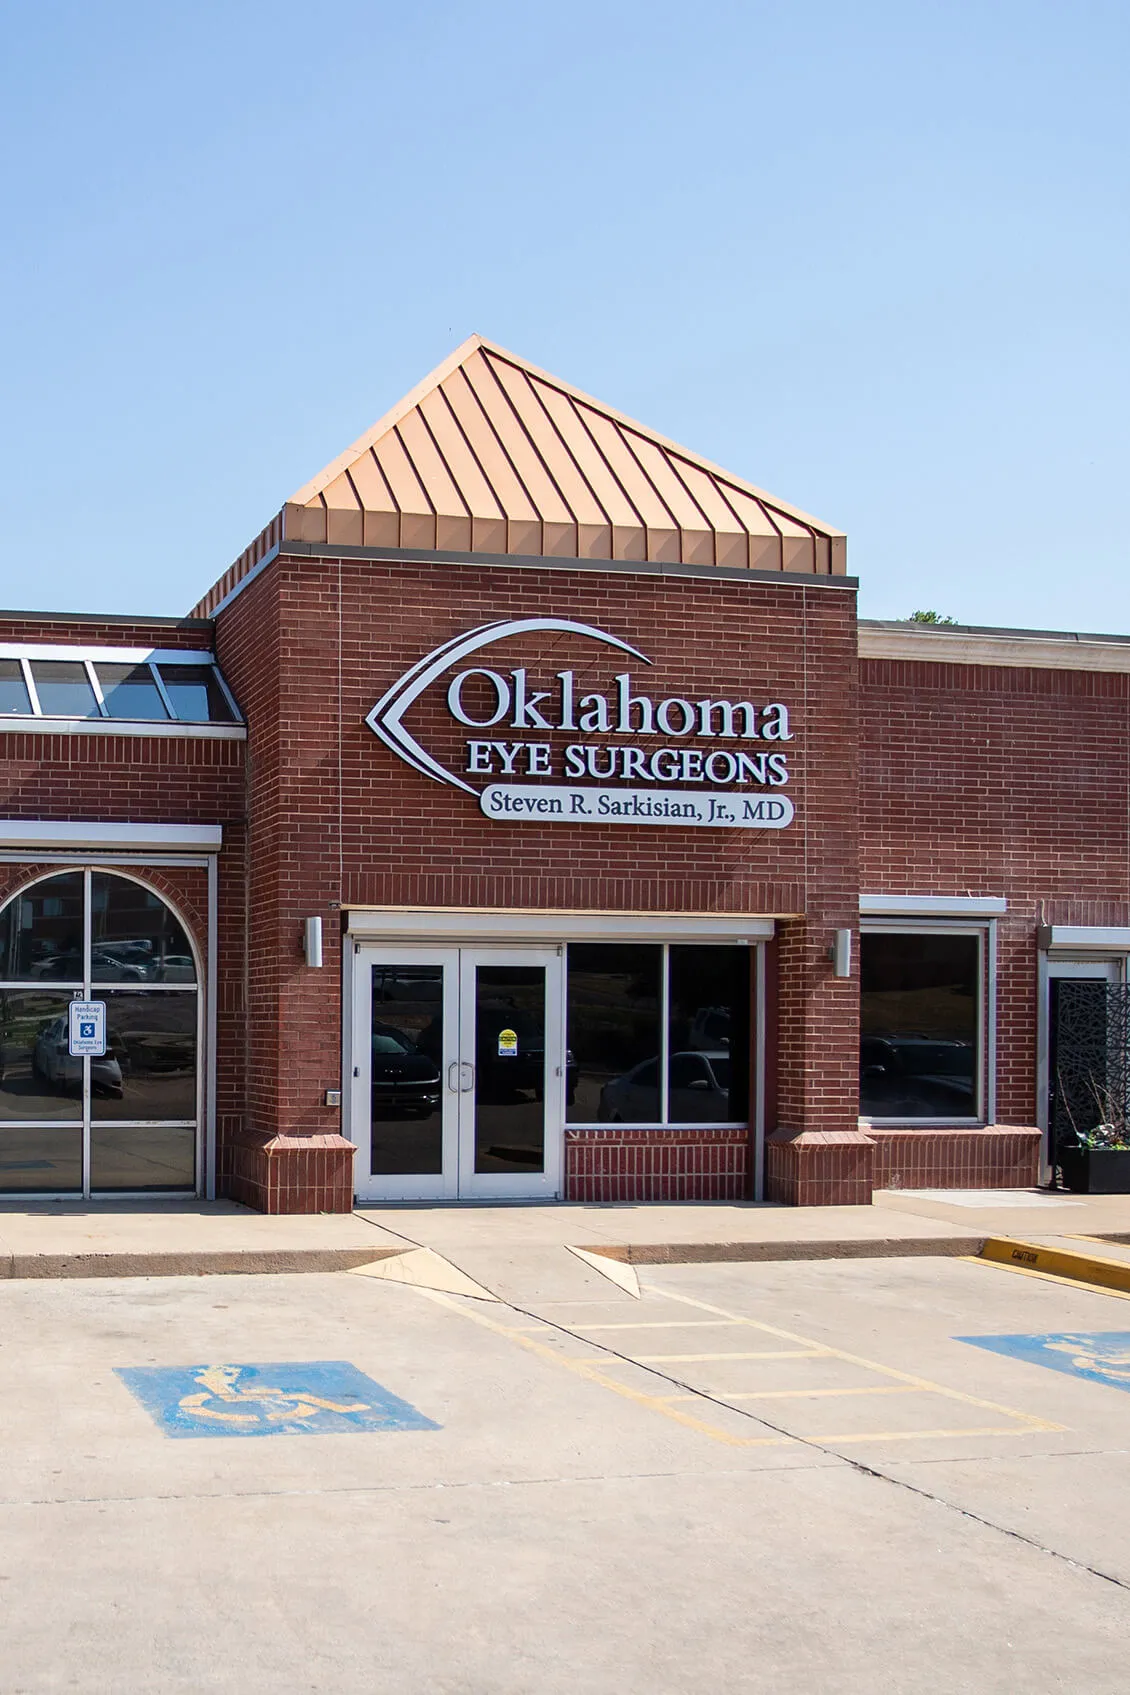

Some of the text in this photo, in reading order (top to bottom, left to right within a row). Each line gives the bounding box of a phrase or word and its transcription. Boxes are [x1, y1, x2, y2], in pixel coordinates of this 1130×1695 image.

[447, 668, 794, 741] Oklahoma
[466, 741, 789, 786] EYE SURGEONS
[490, 791, 785, 822] Steven R. Sarkisian, Jr., MD
